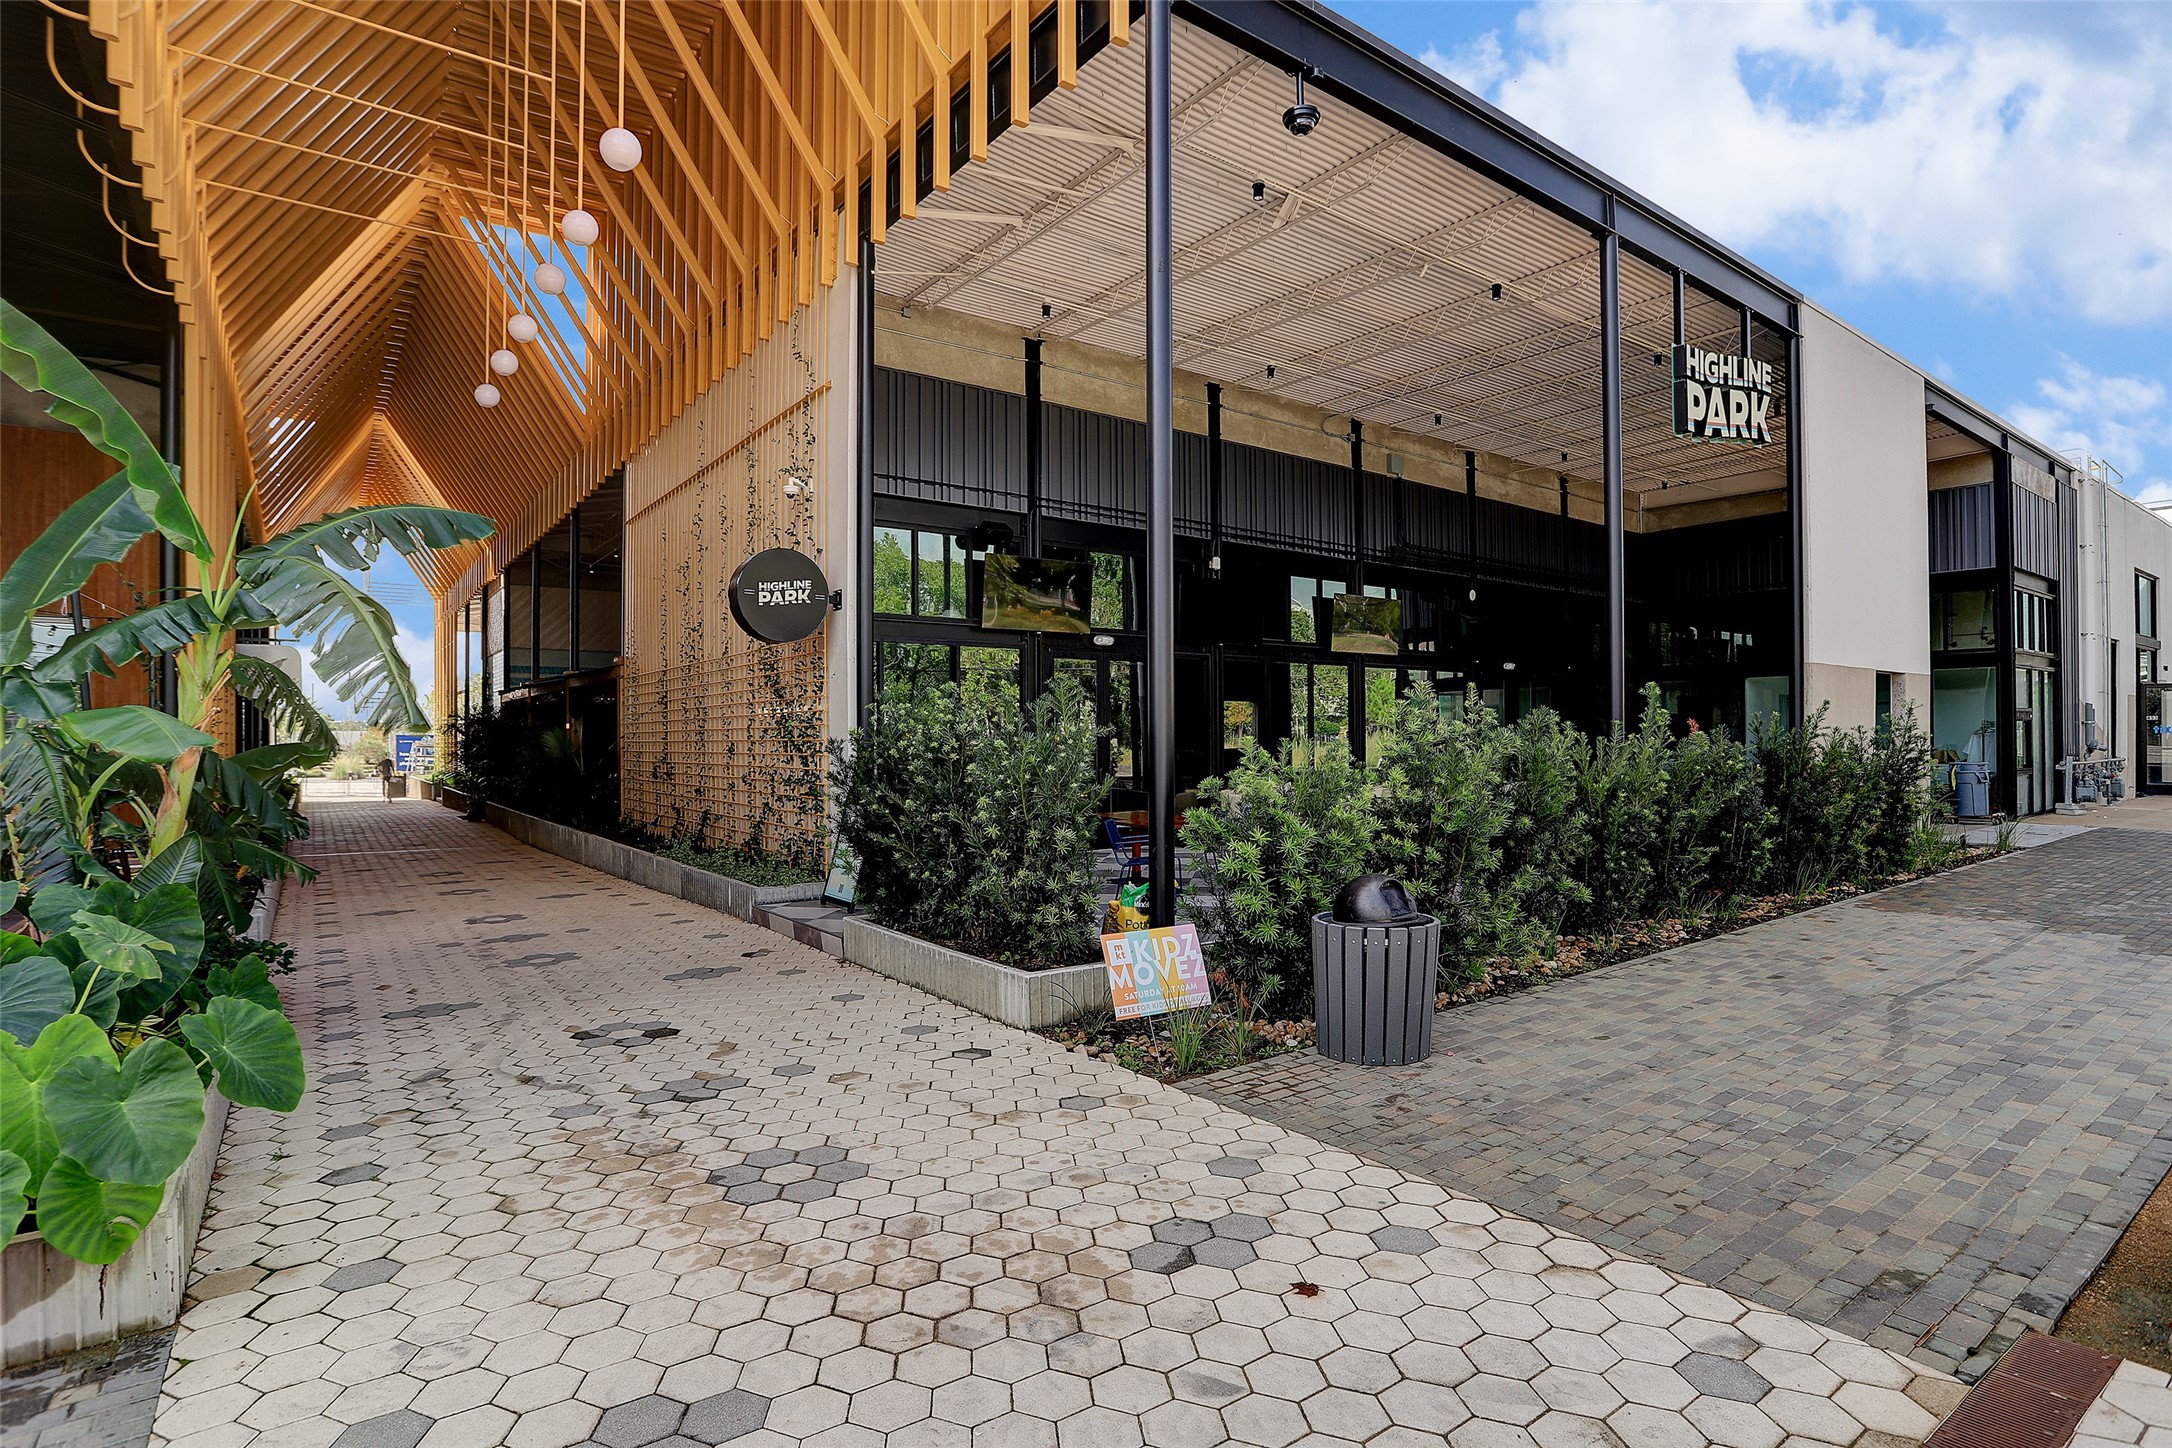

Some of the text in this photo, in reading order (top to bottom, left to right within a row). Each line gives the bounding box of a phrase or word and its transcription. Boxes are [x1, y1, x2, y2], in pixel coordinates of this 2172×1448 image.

[1686, 343, 1772, 394] HIGHLINE
[1686, 379, 1773, 443] PARK
[758, 580, 812, 591] HIGHLINE
[758, 589, 811, 606] PARK
[1125, 919, 1149, 930] Pott
[1133, 933, 1197, 962] KIDZ
[1109, 953, 1206, 990] MOVEZ
[1124, 988, 1165, 1000] SATURDAY
[1119, 1006, 1135, 1015] FREE
[1137, 1003, 1151, 1012] FOR
[1152, 1001, 1168, 1009] KIDS
